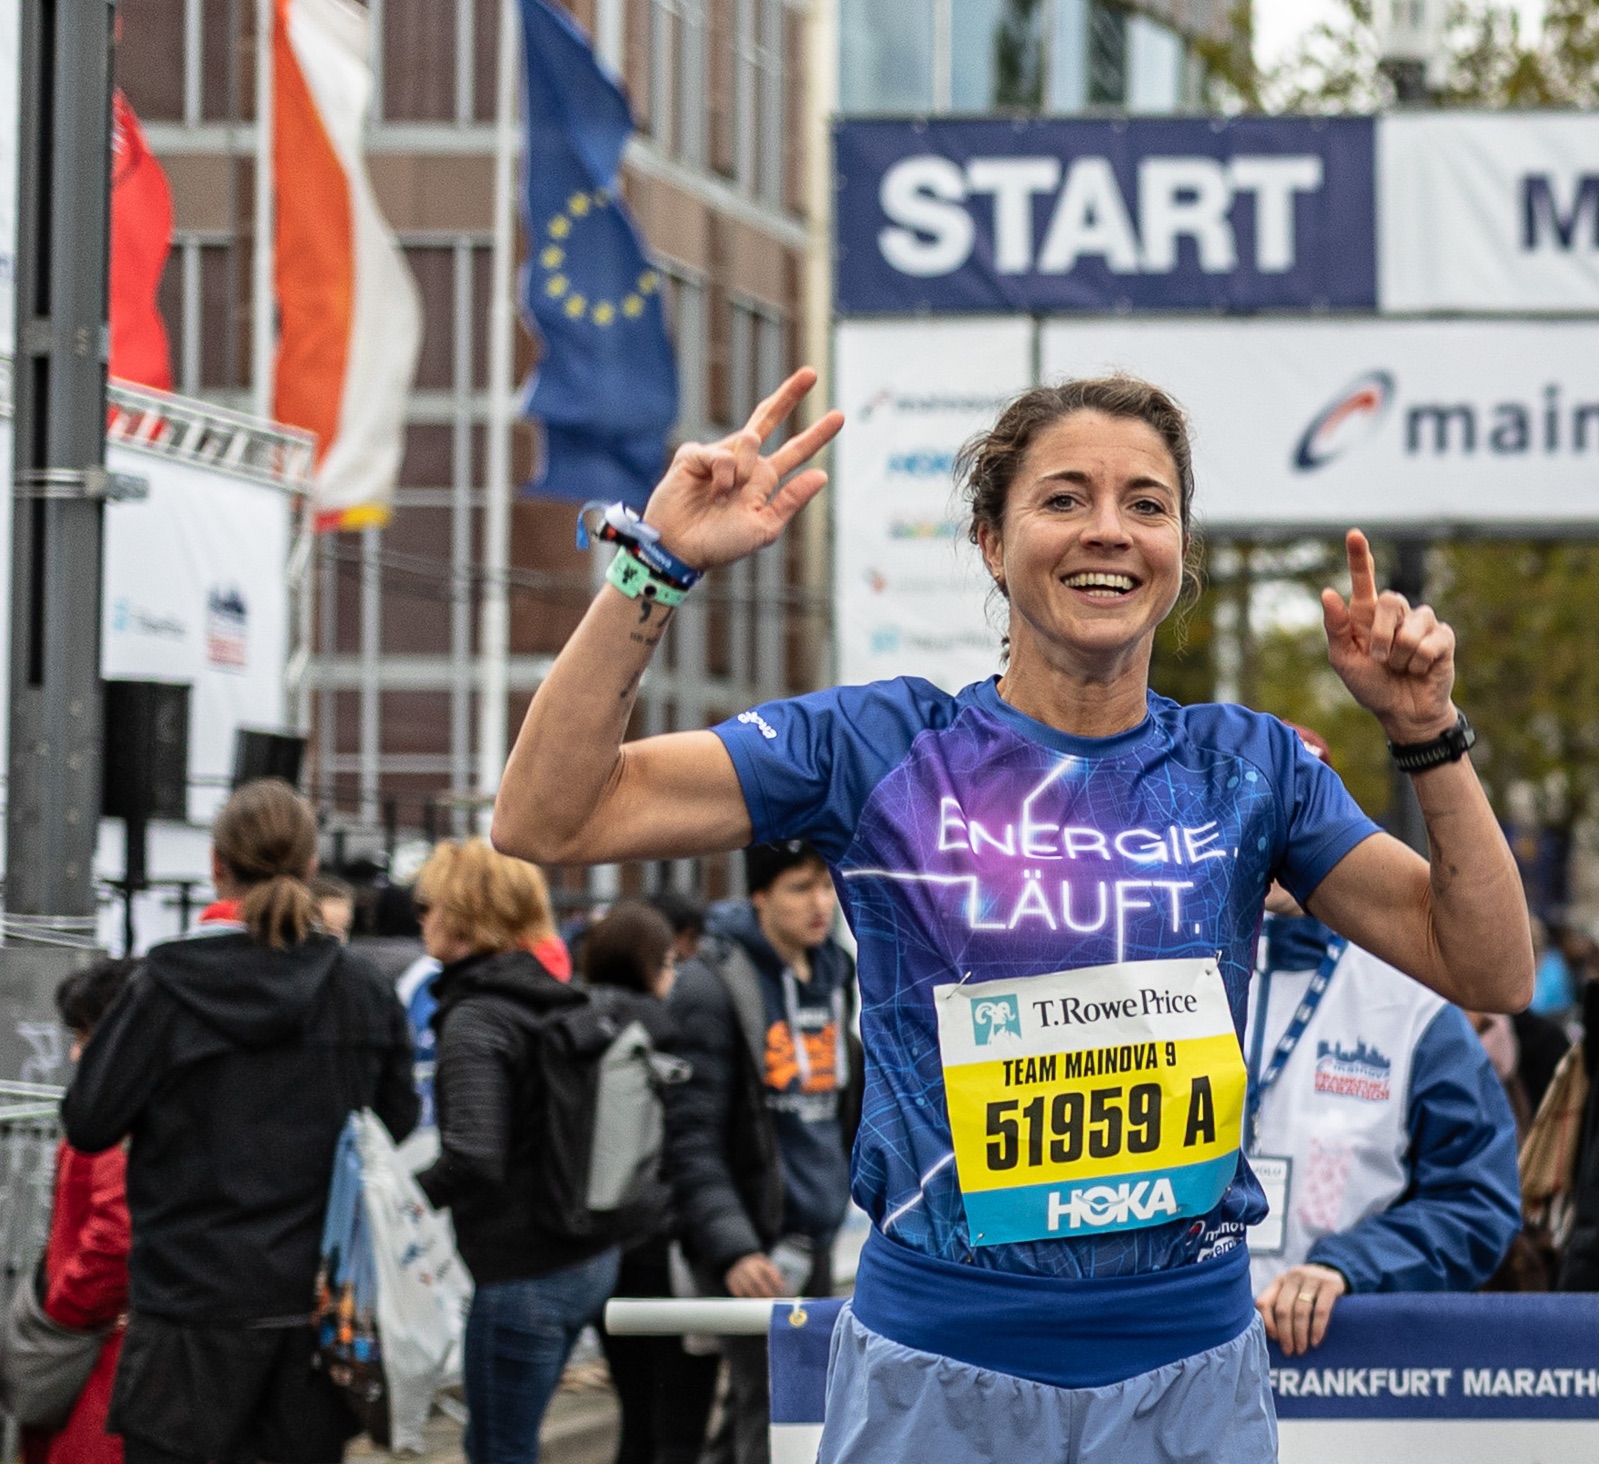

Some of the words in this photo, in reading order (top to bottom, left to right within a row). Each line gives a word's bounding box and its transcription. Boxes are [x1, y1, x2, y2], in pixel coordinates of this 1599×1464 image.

[878, 153, 1325, 278] START
[1003, 1055, 1058, 1087] TEAM
[1064, 1045, 1158, 1080] MAINOVA
[1166, 1041, 1177, 1067] 9
[986, 1082, 1162, 1173] 51959
[1184, 1075, 1216, 1145] A
[1046, 1177, 1178, 1231] HOKA
